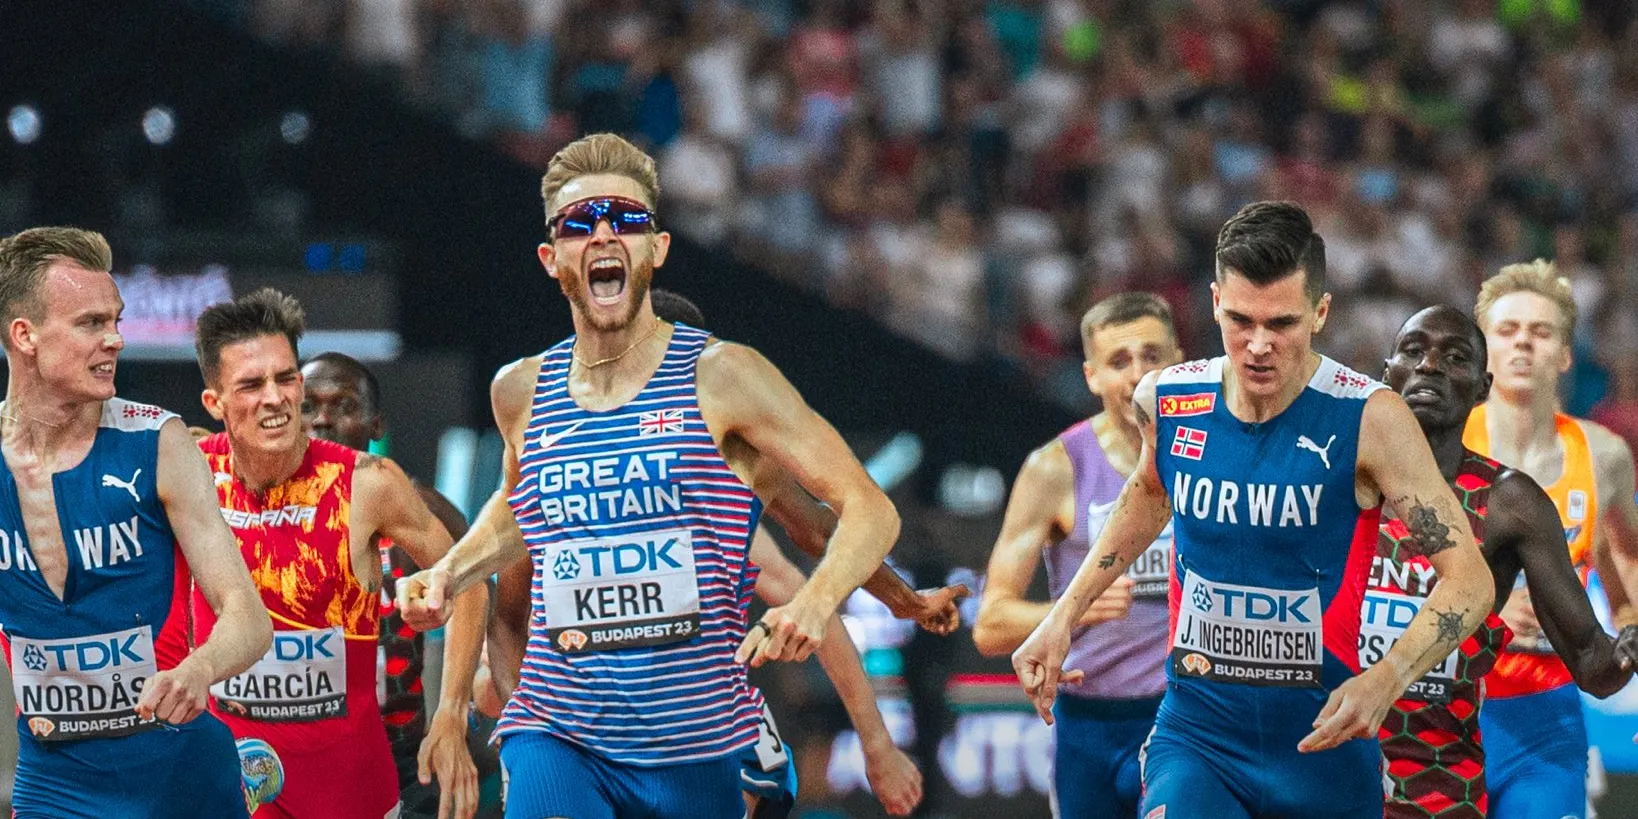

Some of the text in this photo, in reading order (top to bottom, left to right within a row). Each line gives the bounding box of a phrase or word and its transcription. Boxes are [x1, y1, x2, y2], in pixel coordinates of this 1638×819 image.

[1180, 398, 1210, 411] EXTRA
[539, 451, 677, 493] GREAT
[540, 484, 681, 526] BRITAIN
[1173, 470, 1323, 527] NORWAY
[73, 515, 143, 571] WAY
[578, 537, 683, 577] TDK
[574, 581, 665, 621] KERR
[1212, 587, 1311, 623] TDK
[591, 620, 693, 645] BUDAPEST 23
[1181, 614, 1194, 646] J.
[1199, 620, 1316, 660] INGEBRIGTSEN
[44, 633, 144, 671] TDK
[224, 666, 333, 699] GARCÍA
[1214, 663, 1313, 681] BUDAPEST 23
[1428, 683, 1445, 695] 23
[22, 673, 146, 713] NORDÅS
[251, 700, 340, 717] BUDAPEST 23
[59, 715, 136, 732] BUDAPEST
